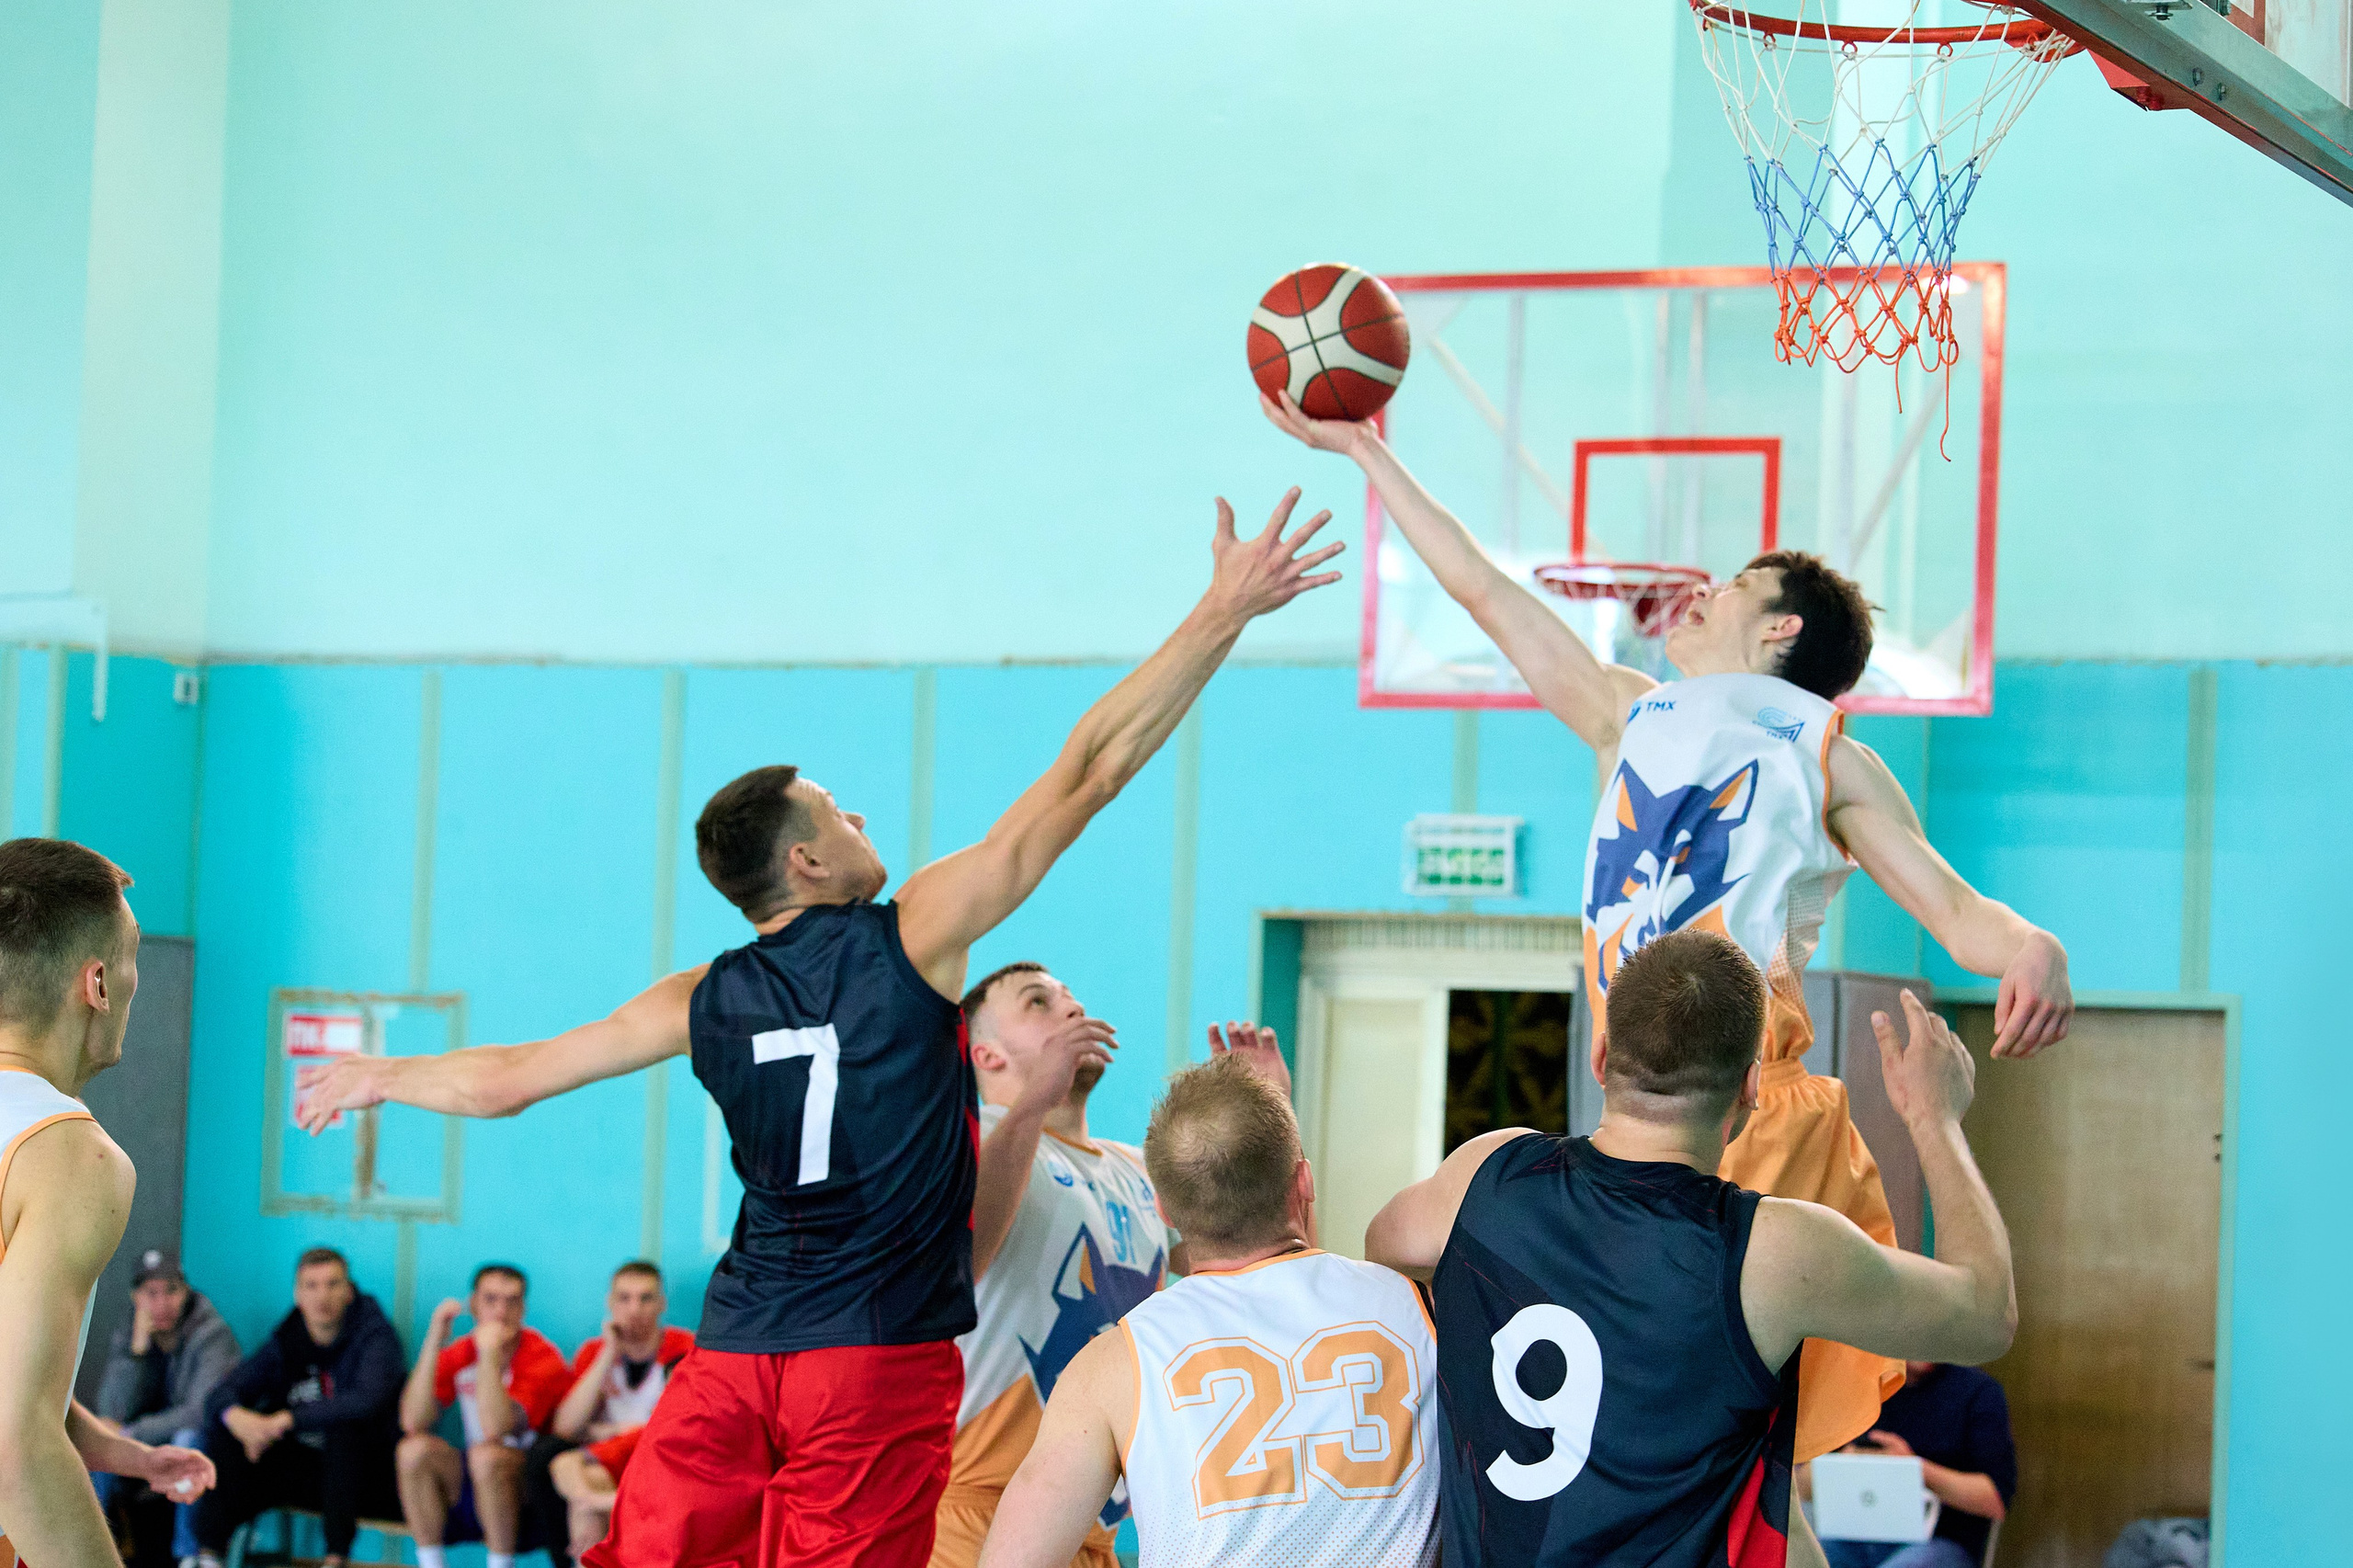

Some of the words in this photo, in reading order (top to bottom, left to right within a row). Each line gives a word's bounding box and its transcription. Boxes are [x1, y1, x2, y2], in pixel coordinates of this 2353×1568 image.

[751, 1022, 841, 1186] 7
[1162, 1320, 1426, 1521] 23
[1484, 1302, 1604, 1502] 9
